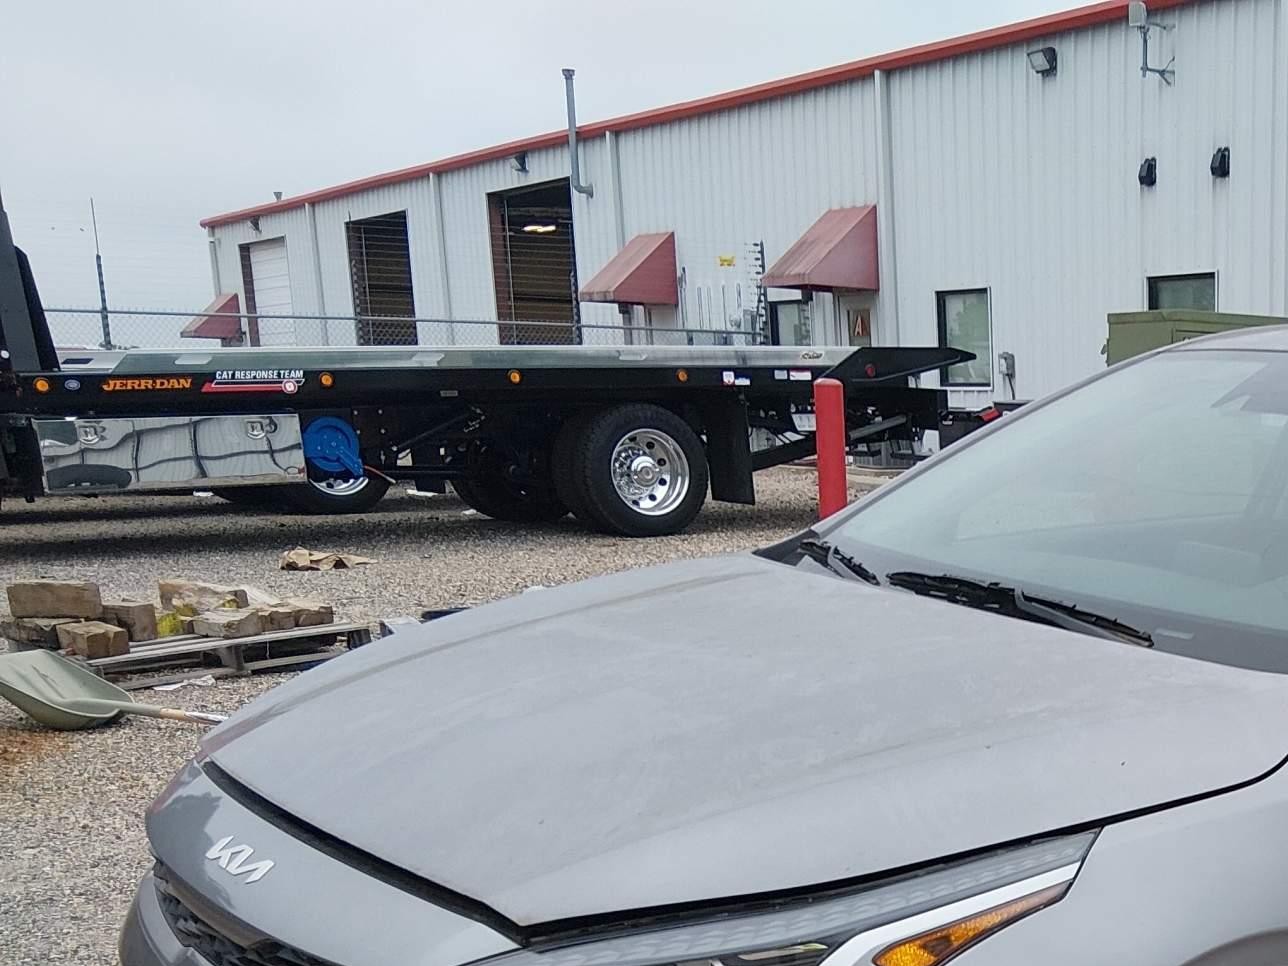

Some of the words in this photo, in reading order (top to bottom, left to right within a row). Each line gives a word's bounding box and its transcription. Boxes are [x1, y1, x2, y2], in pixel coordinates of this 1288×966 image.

[215, 370, 232, 379] CAT
[234, 370, 278, 379] RESPONSE
[280, 370, 304, 379] TEAM
